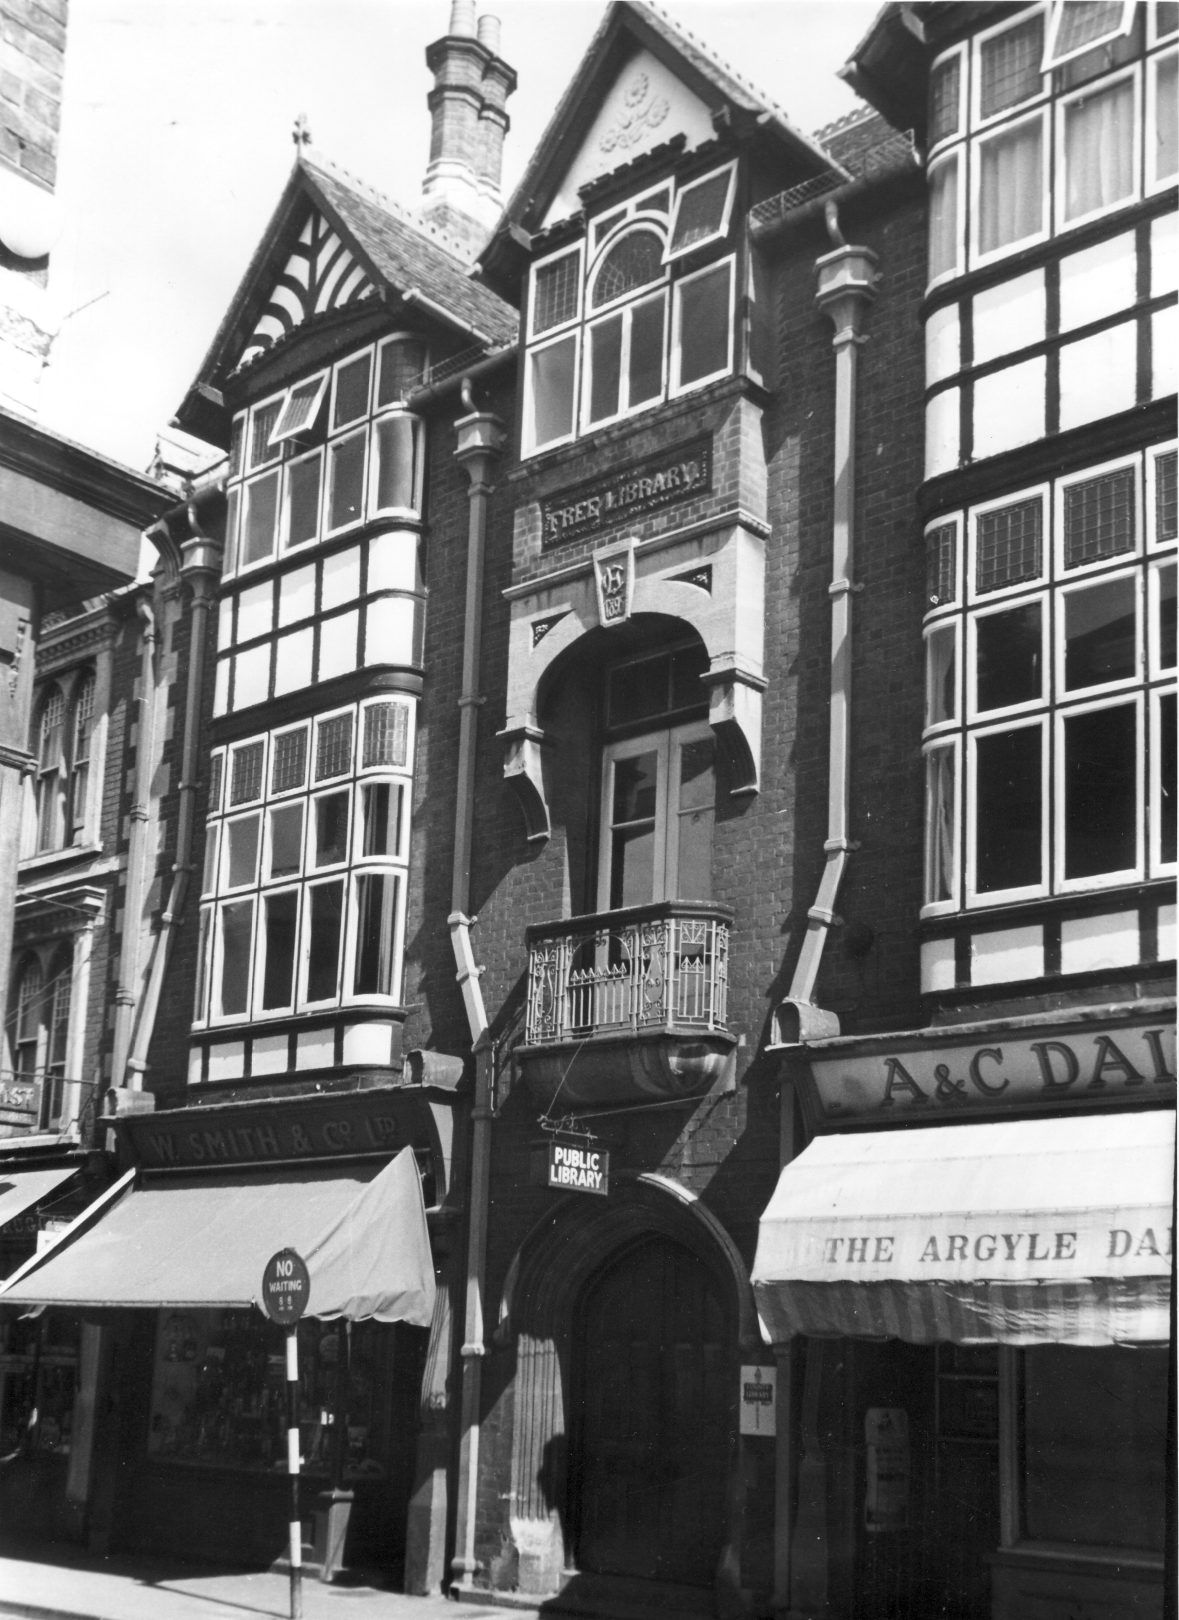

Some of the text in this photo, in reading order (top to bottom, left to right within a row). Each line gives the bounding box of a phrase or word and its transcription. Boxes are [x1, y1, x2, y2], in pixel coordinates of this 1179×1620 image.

[548, 460, 699, 538] FREE LIBRARY
[1030, 1029, 1177, 1091] DAI
[188, 1126, 280, 1159] SMITH
[290, 1123, 314, 1155] &
[554, 1146, 600, 1171] PUBLIC
[550, 1164, 603, 1189] LIBRARY
[825, 1236, 896, 1264] THE
[918, 1232, 1078, 1262] ARGYLE
[275, 1259, 293, 1278] NO
[269, 1279, 302, 1293] WAITING
